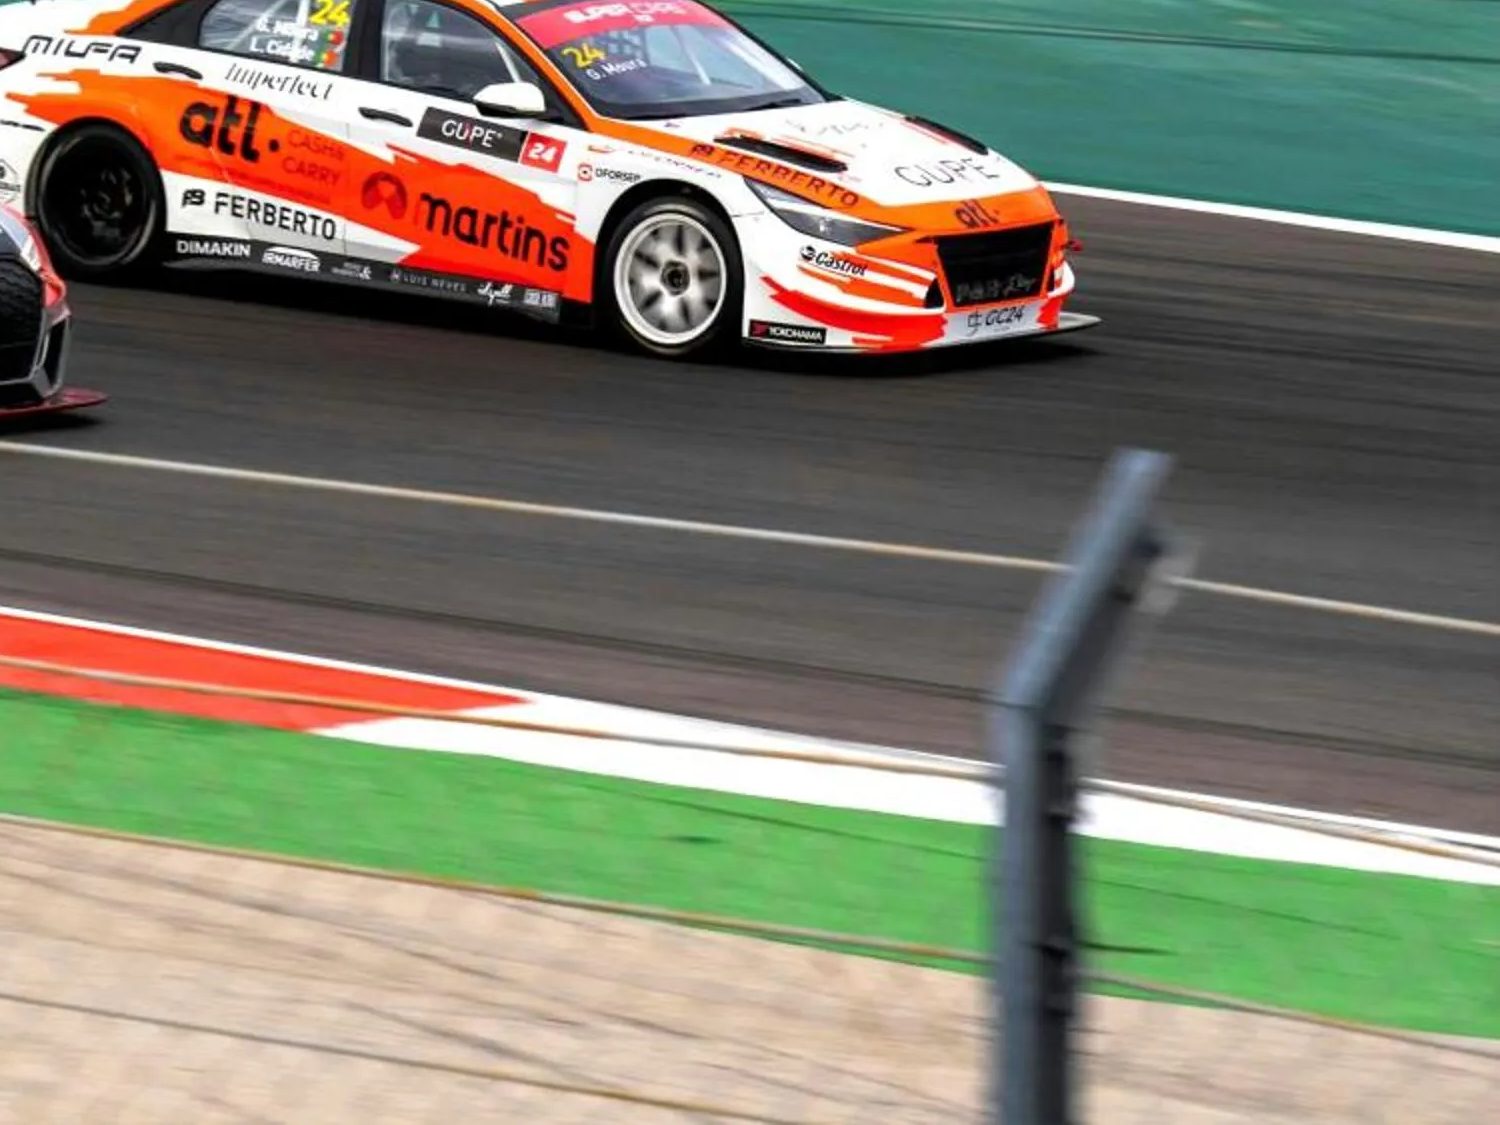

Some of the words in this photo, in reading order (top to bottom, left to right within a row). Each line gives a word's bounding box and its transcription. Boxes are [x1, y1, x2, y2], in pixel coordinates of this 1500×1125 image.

[21, 34, 143, 64] MILFA
[561, 42, 607, 69] 24
[528, 141, 559, 162] 24
[718, 150, 859, 207] FERBERTO
[213, 191, 337, 241] FERBERTO
[415, 192, 570, 272] martins
[176, 240, 252, 258] DIMAKIN
[815, 251, 869, 277] Castrol
[768, 326, 823, 342] YOKOHAMA
